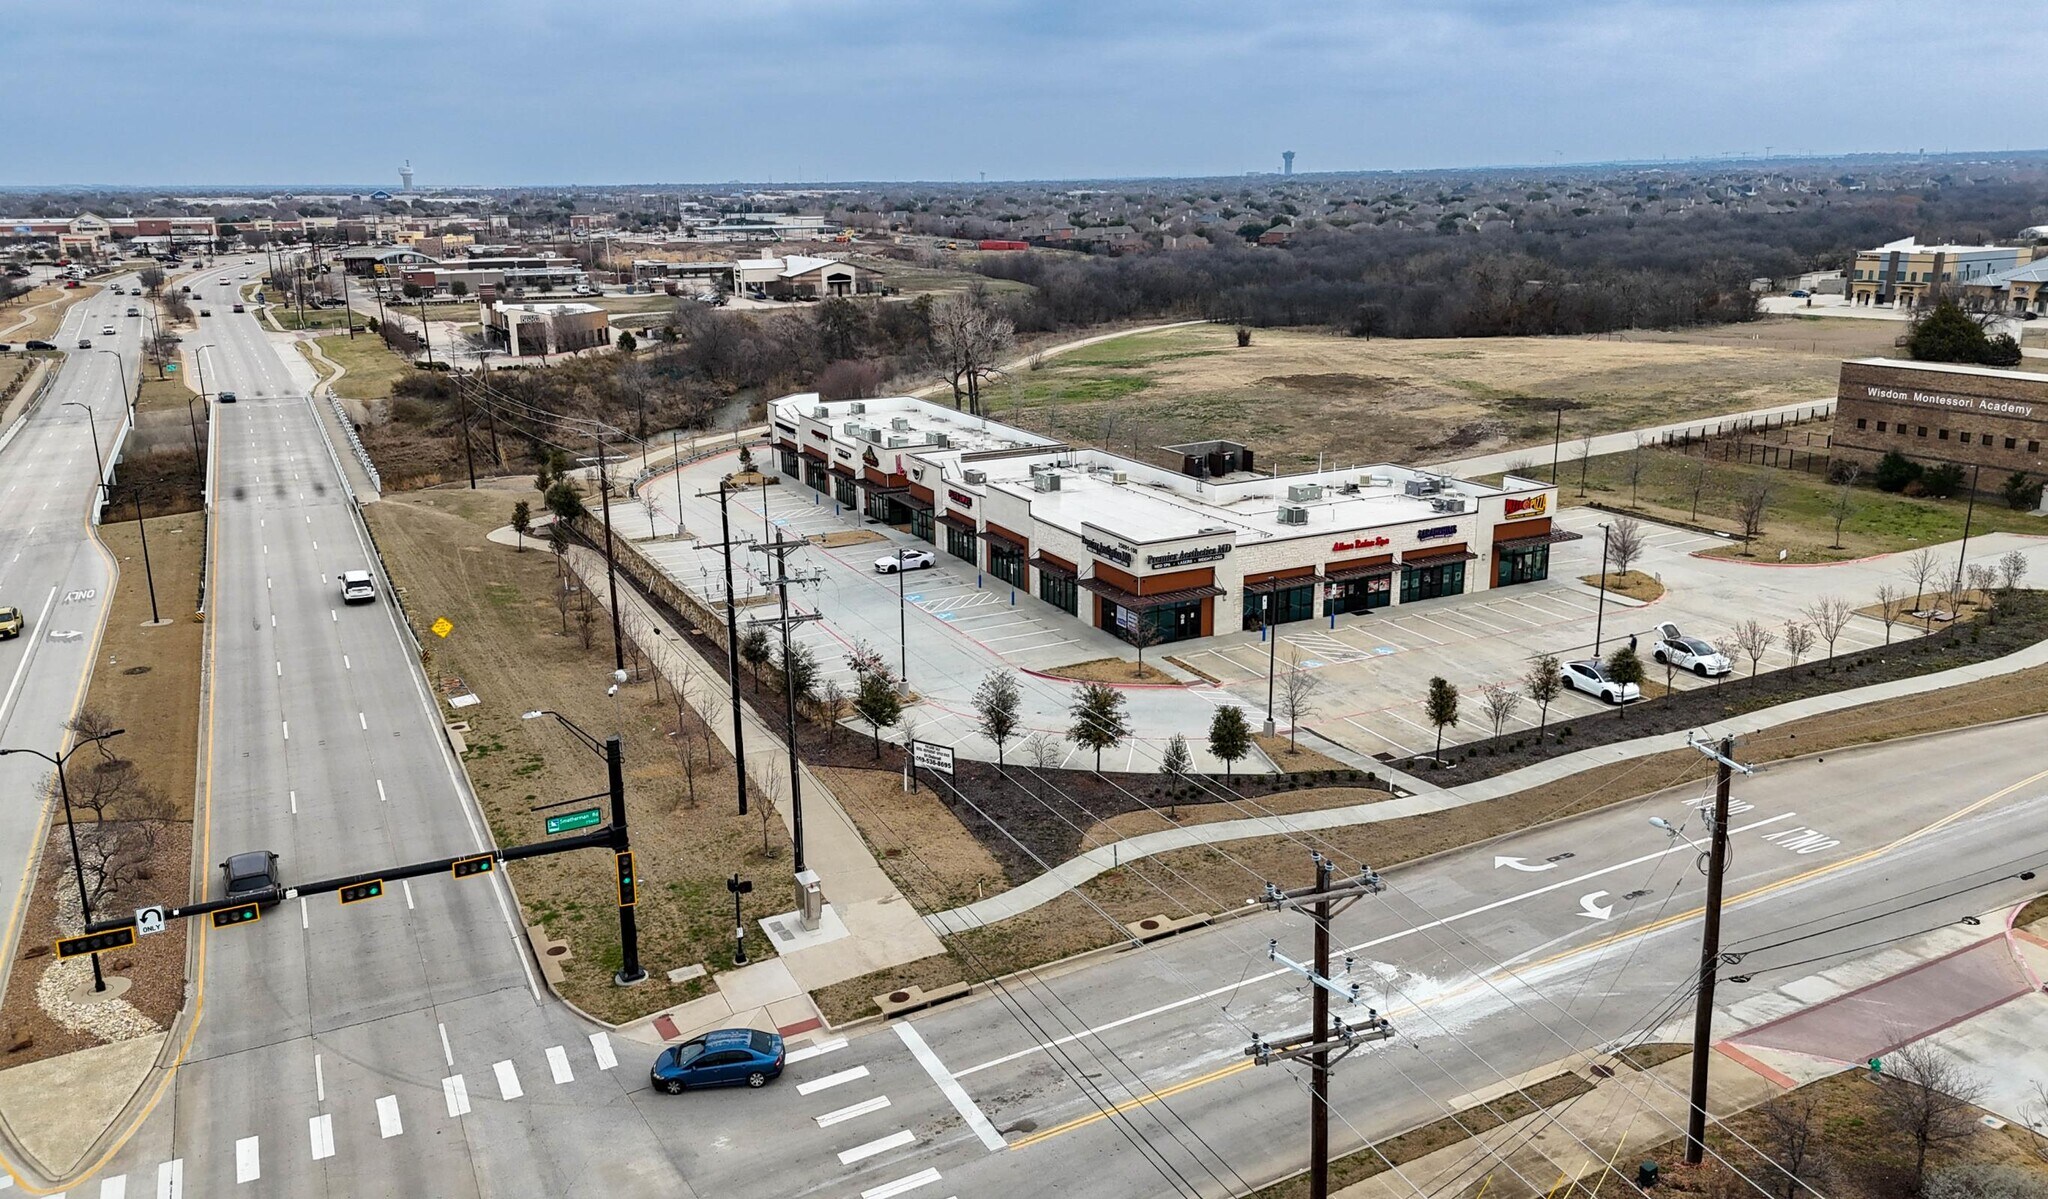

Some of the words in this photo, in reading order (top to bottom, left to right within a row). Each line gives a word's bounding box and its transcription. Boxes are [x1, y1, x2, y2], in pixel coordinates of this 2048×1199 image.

[1867, 387, 1908, 400] Wisdom
[1913, 392, 1974, 408] Montessori
[1979, 399, 2033, 416] Academy
[1375, 536, 1390, 548] Spa
[1147, 551, 1178, 564] Premier
[1179, 545, 1217, 560] Aesthetics
[1217, 543, 1232, 554] MD
[64, 589, 96, 602] ONLY
[1761, 826, 1841, 854] ONLY
[142, 924, 161, 933] ONLY
